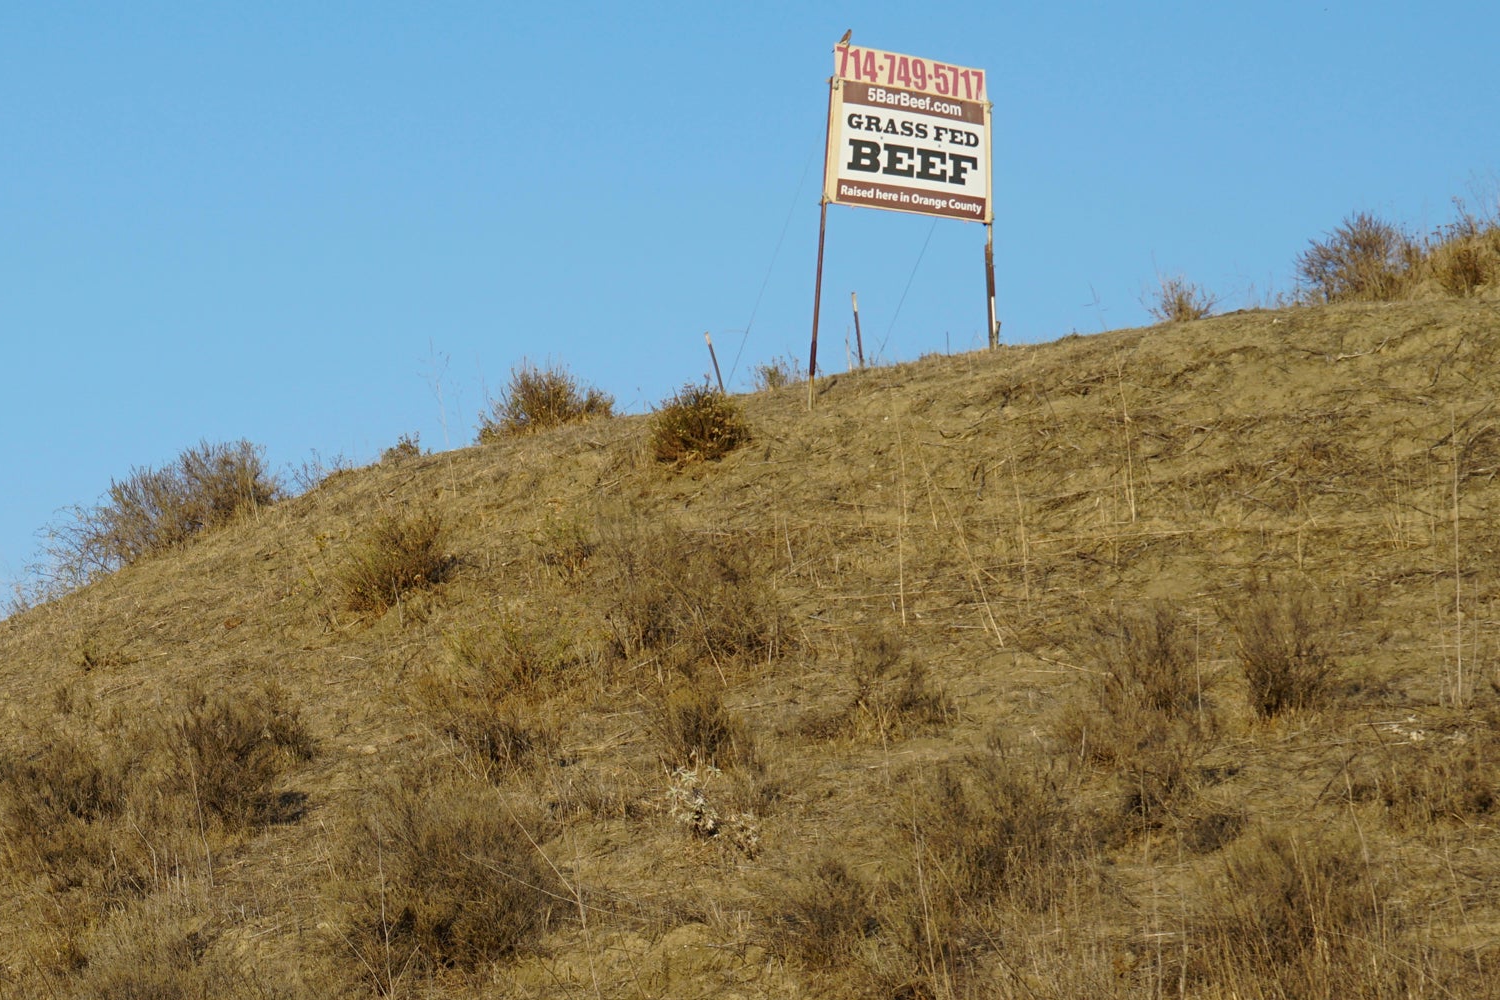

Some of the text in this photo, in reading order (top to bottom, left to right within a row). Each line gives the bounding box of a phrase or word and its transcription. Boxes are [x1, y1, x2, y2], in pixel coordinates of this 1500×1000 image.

[867, 87, 962, 116] 5BarBeef.com
[847, 113, 979, 148] GRASS FED
[847, 138, 978, 186] BEEF
[840, 184, 982, 214] Raised here in Orange County
